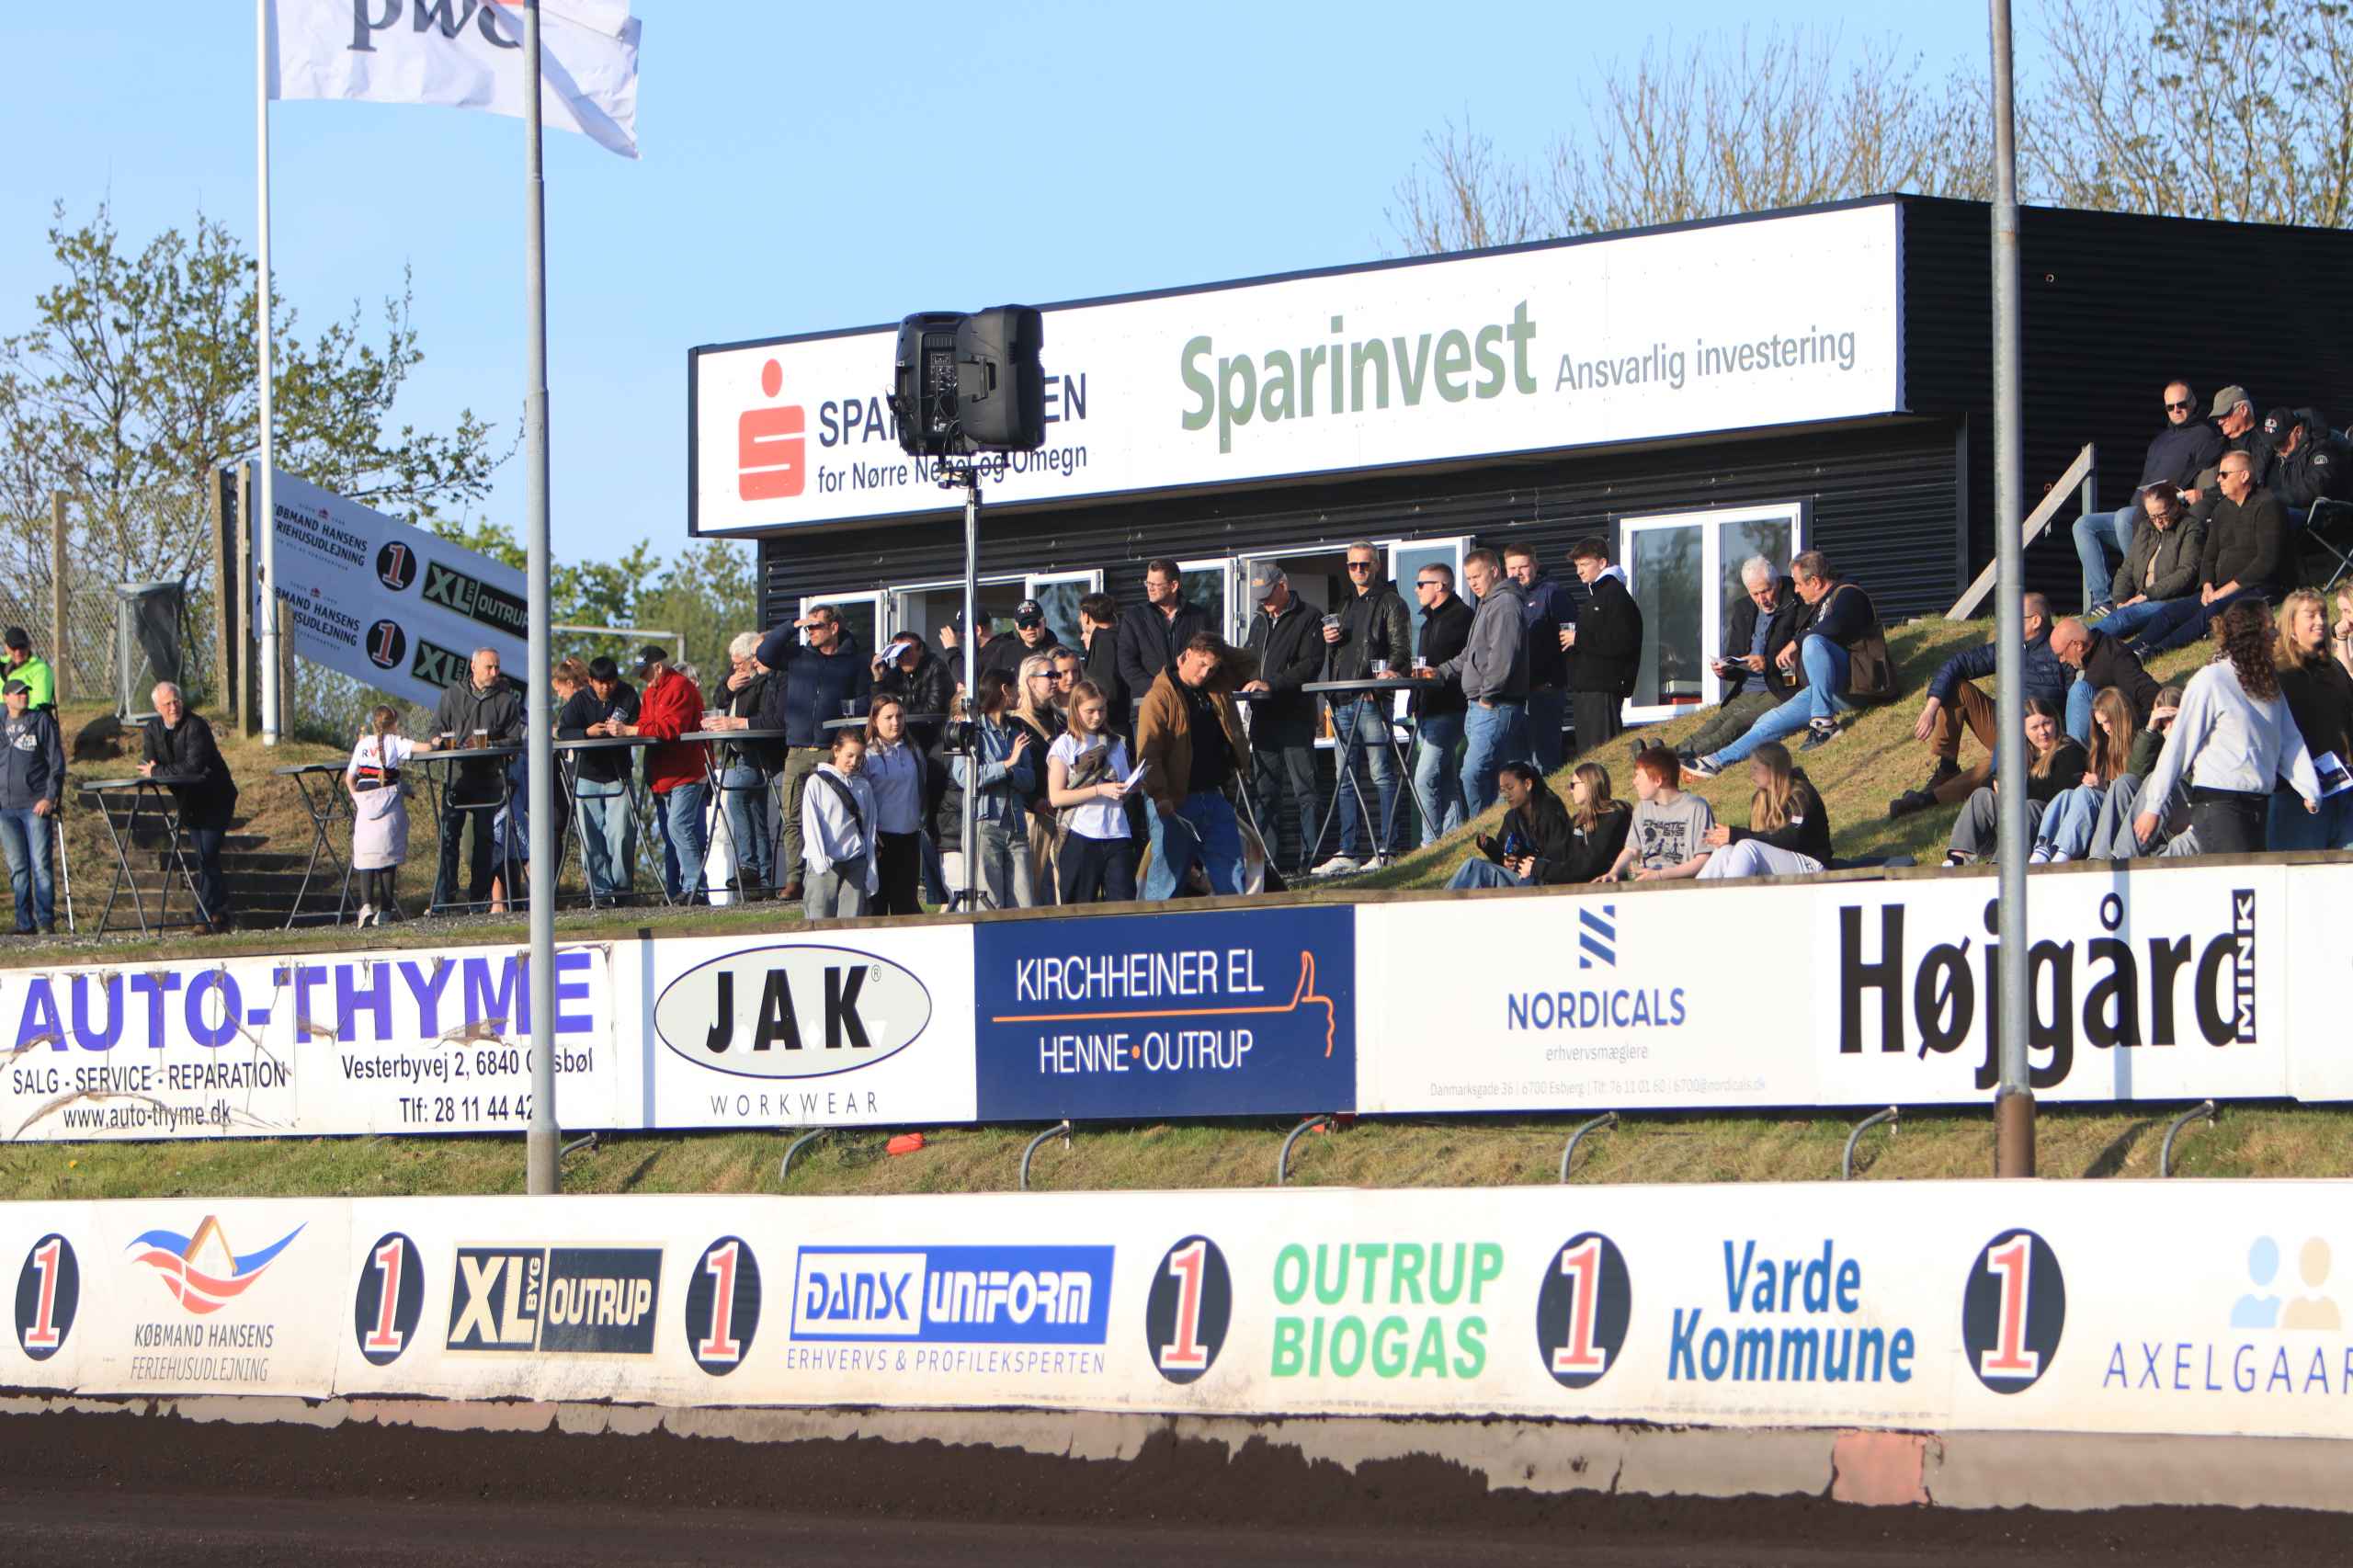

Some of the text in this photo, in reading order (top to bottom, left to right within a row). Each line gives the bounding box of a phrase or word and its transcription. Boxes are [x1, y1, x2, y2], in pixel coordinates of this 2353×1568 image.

[1181, 299, 1537, 453] Sparinvest
[1555, 325, 1856, 392] Ansvarlig investering
[818, 465, 846, 494] for
[853, 461, 907, 489] Nørre
[1013, 445, 1086, 476] Omegn
[322, 524, 368, 551] HANSENS
[383, 543, 404, 588] 1
[314, 603, 360, 631] HANSENS
[426, 565, 470, 612] XL
[371, 622, 395, 666] 1
[1016, 949, 1264, 1001] KIRCHHEINER EL
[2237, 894, 2254, 1037] MINK
[14, 952, 593, 1051] AUTO-THYME
[705, 965, 870, 1053] JAK
[1507, 988, 1687, 1030] NORDICALS
[13, 1068, 59, 1095] SALG
[75, 1066, 152, 1093] SERVICE
[169, 1062, 287, 1090] REPARATION
[342, 1053, 448, 1084] Vesterbyvej
[476, 1050, 519, 1075] 6840
[63, 1099, 232, 1132] www.auto-thyme.dk
[399, 1097, 427, 1122] Tlf:
[435, 1096, 455, 1122] 28
[461, 1096, 479, 1121] 11
[487, 1096, 509, 1120] 44
[710, 1091, 878, 1117] WORKWEAR
[25, 1239, 61, 1347] 1
[365, 1238, 404, 1353] 1
[449, 1256, 652, 1343] XL BYG OUTRUP
[699, 1242, 739, 1362] 1
[1273, 1242, 1504, 1306] OUTRUP
[1722, 1239, 1860, 1313] Varde
[1160, 1241, 1207, 1369] 1
[1552, 1238, 1605, 1373] 1
[1980, 1234, 2039, 1378] 1
[134, 1324, 274, 1348] KØBMAND HANSENS
[787, 1348, 1104, 1373] ERHVERVS & PROFILEKSPERTEN
[1270, 1316, 1487, 1379] BIOGAS
[1667, 1308, 1915, 1382] Kommune
[131, 1357, 268, 1381] FERIEHUSUDLEJNING
